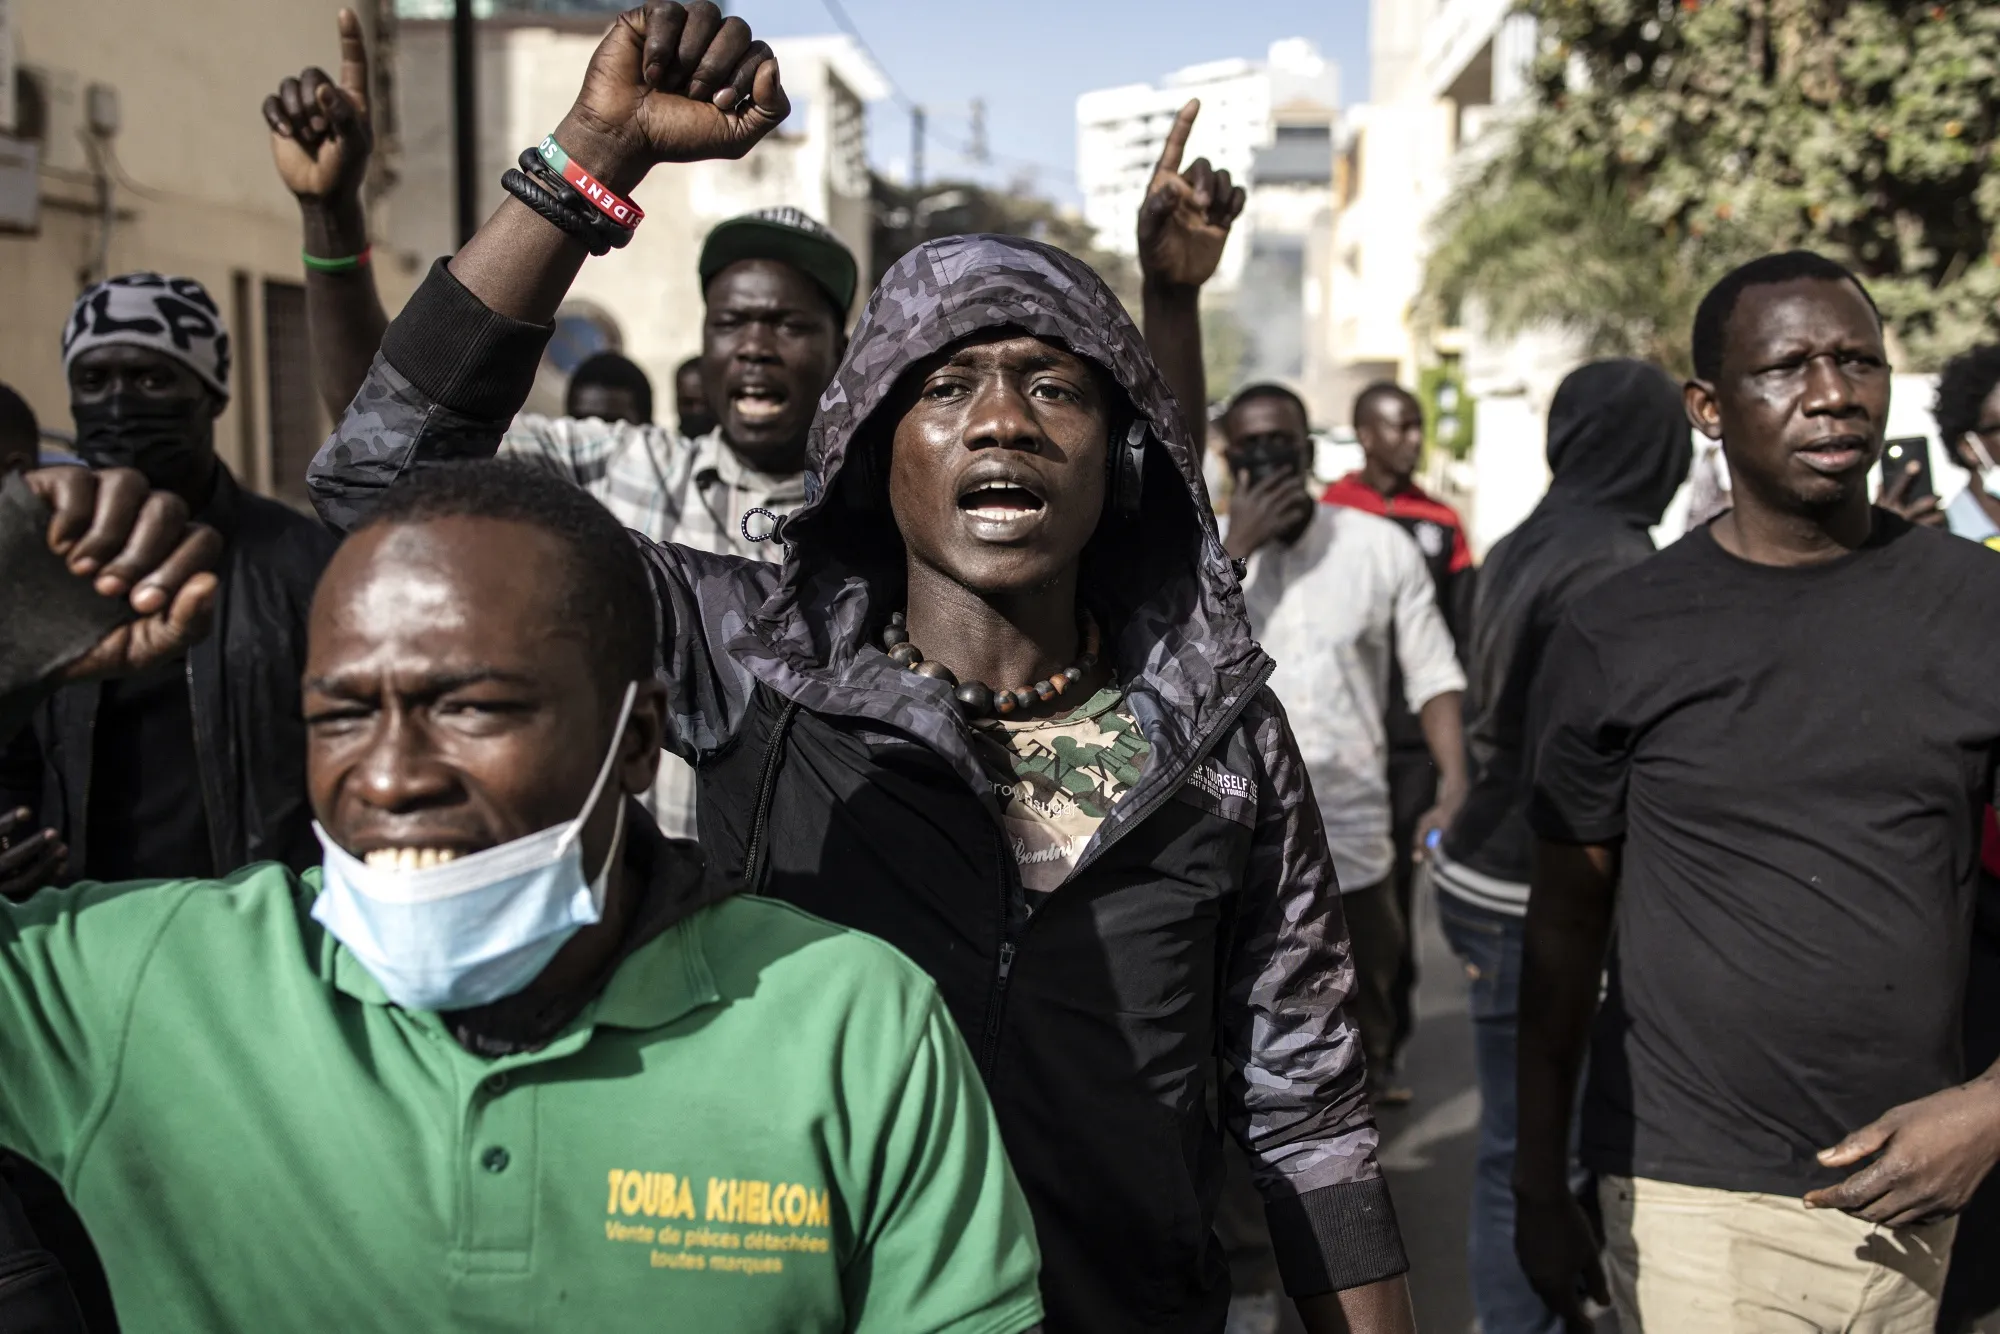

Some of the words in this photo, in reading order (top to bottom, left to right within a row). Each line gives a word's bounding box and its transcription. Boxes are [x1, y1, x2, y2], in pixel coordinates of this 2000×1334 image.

[1205, 765, 1248, 791] YOURSELF
[607, 1168, 696, 1219] TOUBA
[705, 1177, 830, 1228] KHELCOM
[606, 1220, 655, 1244] Vente
[658, 1226, 681, 1245] de
[685, 1228, 740, 1250] pièces
[744, 1231, 829, 1253] détachées
[651, 1250, 706, 1270] toutes
[710, 1255, 783, 1276] marques
